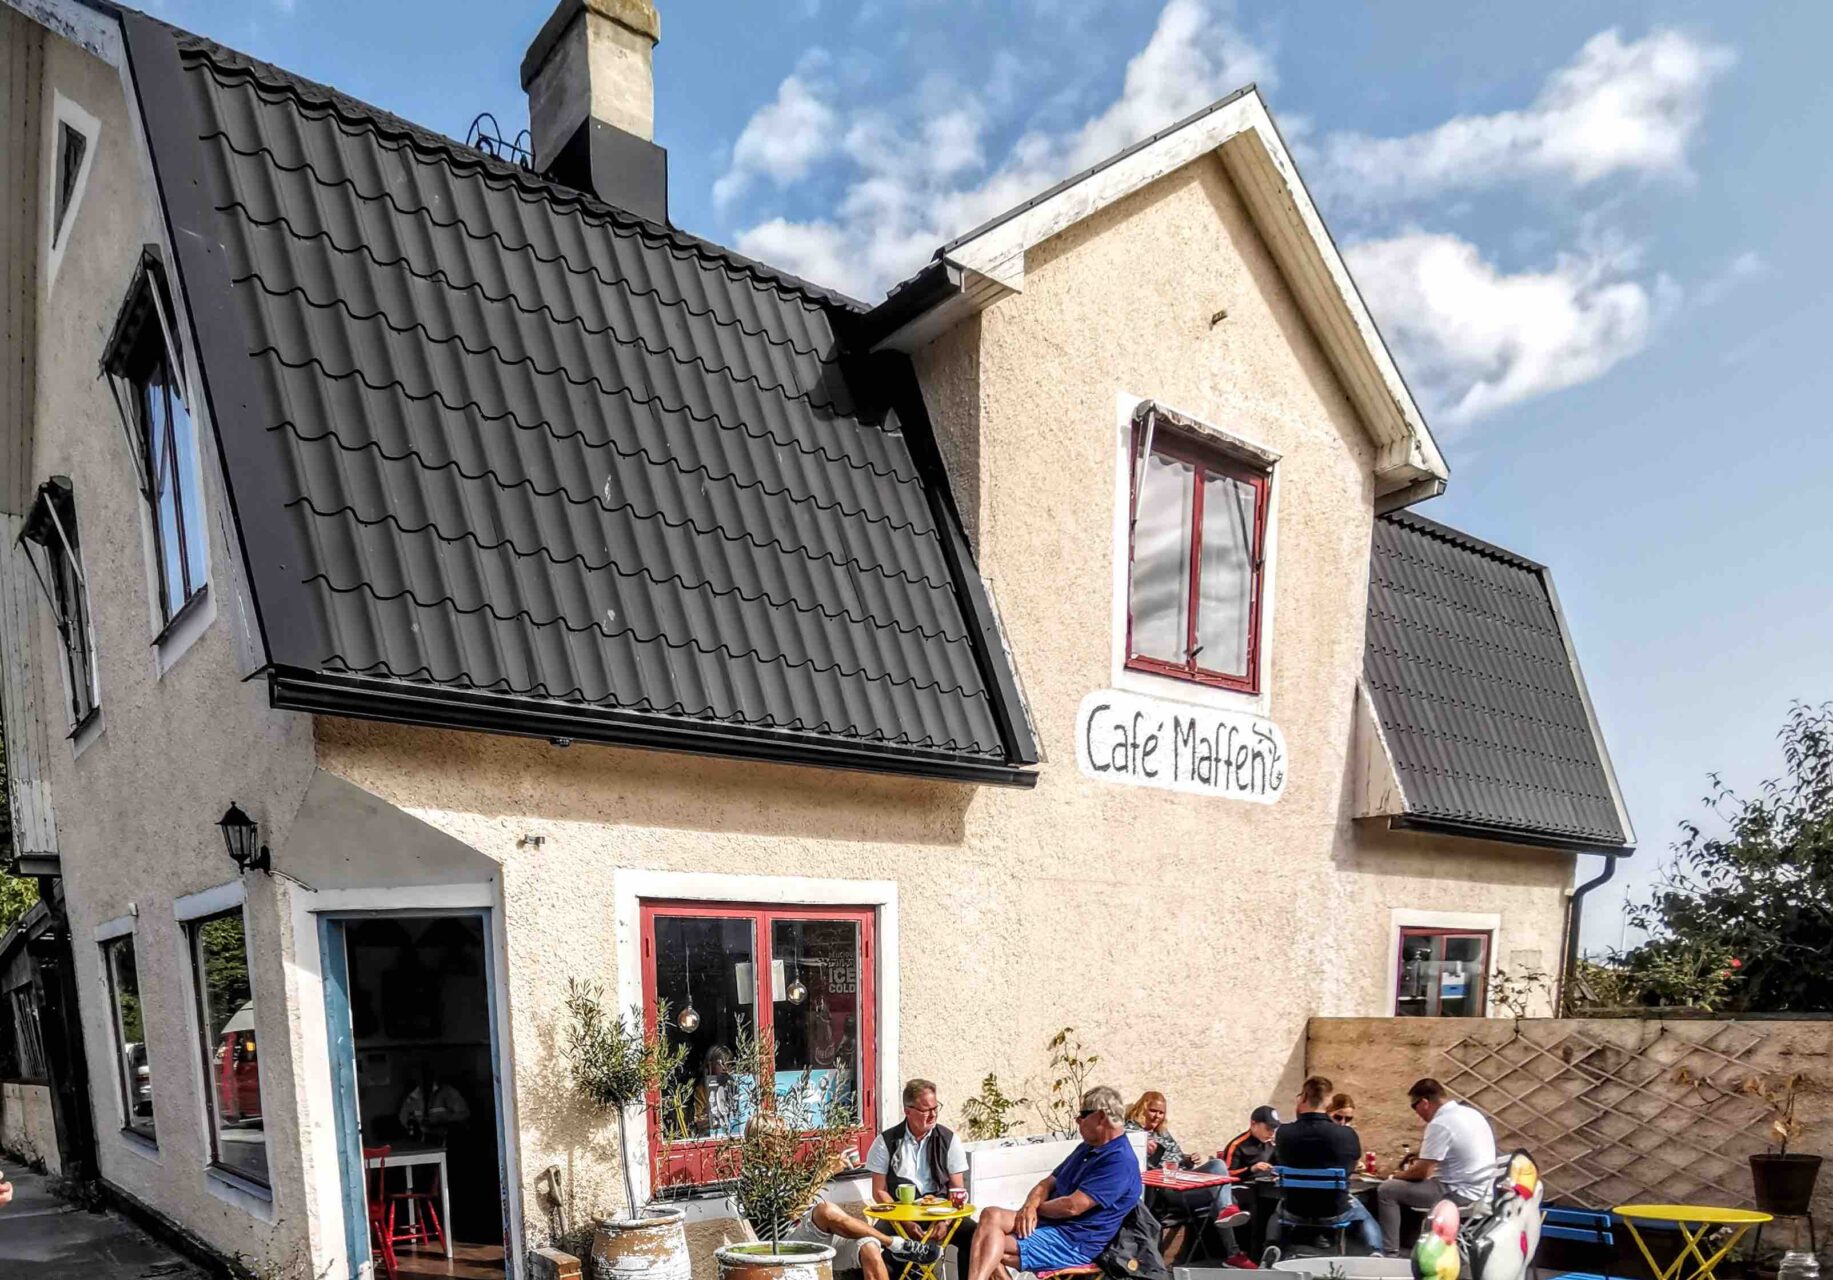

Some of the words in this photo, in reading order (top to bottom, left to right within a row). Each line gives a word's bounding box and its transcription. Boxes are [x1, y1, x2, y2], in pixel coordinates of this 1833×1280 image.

[1087, 703, 1164, 777] Café
[828, 967, 856, 983] ICE
[828, 983, 856, 993] COLD
